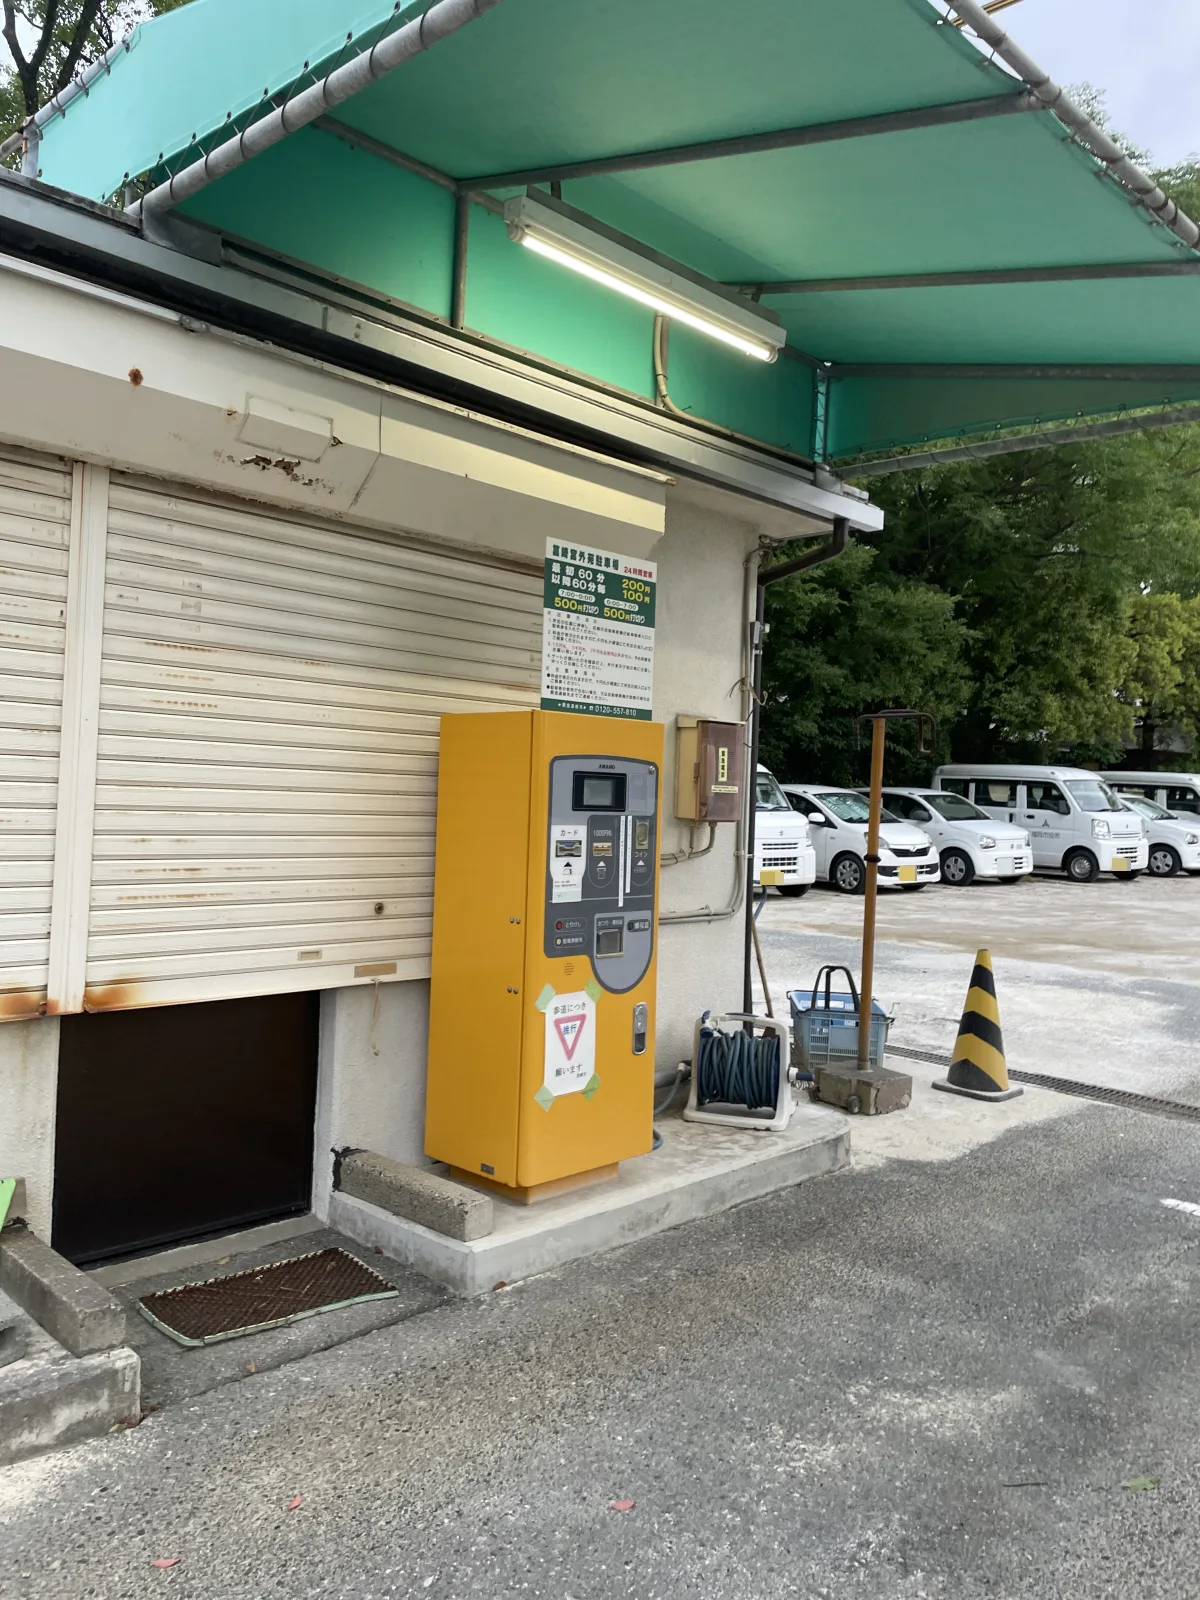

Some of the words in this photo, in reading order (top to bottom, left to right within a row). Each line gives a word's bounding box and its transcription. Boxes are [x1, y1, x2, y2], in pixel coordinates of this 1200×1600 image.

[622, 579, 650, 592] 200円
[623, 590, 649, 603] 100円
[595, 705, 636, 715] 0120-557-810
